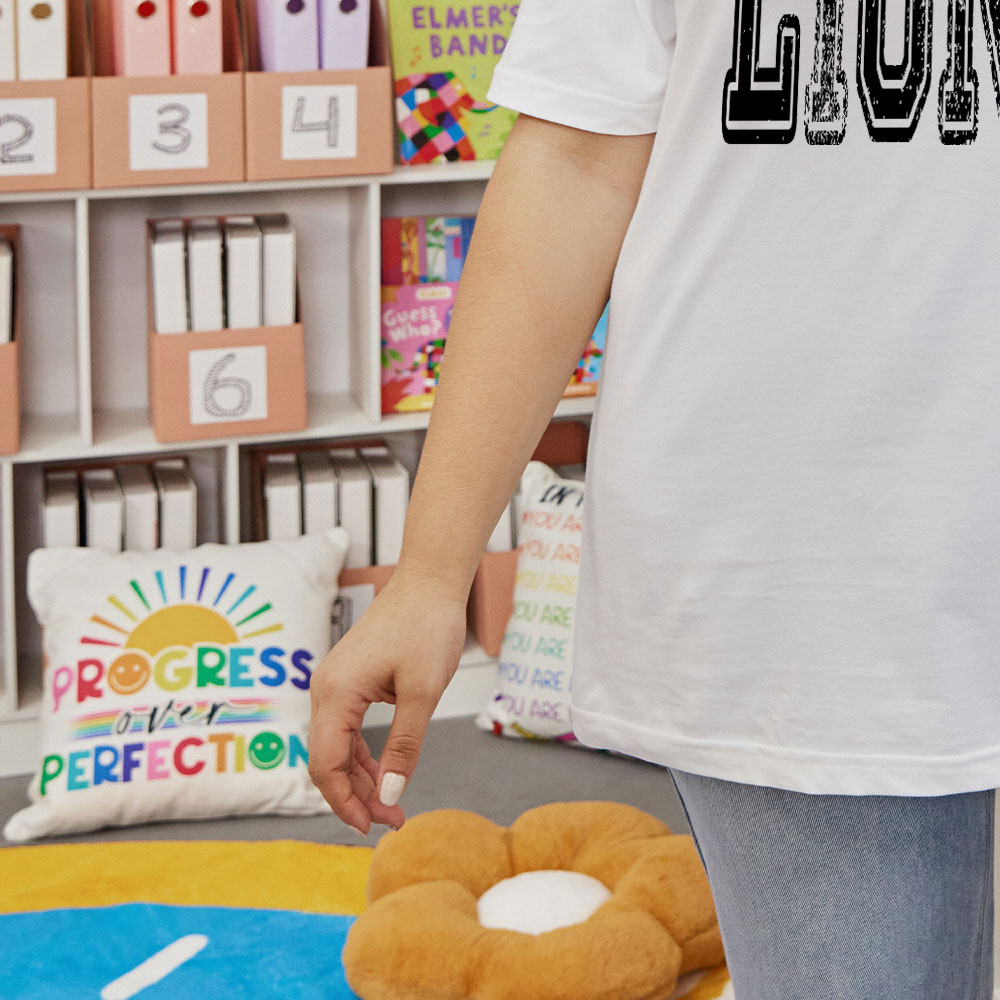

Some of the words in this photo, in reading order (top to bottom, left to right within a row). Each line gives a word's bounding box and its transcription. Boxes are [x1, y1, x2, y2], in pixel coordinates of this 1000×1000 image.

[430, 34, 508, 59] BAND
[0, 113, 35, 164] 2
[151, 102, 193, 155] 3
[290, 96, 341, 148] 4
[383, 305, 437, 328] Guess
[388, 319, 442, 343] Who?
[203, 351, 252, 418] 6
[52, 647, 313, 713] PROGRESS
[531, 667, 565, 692] ARE
[116, 699, 243, 735] over
[40, 731, 309, 797] PERFECTION
